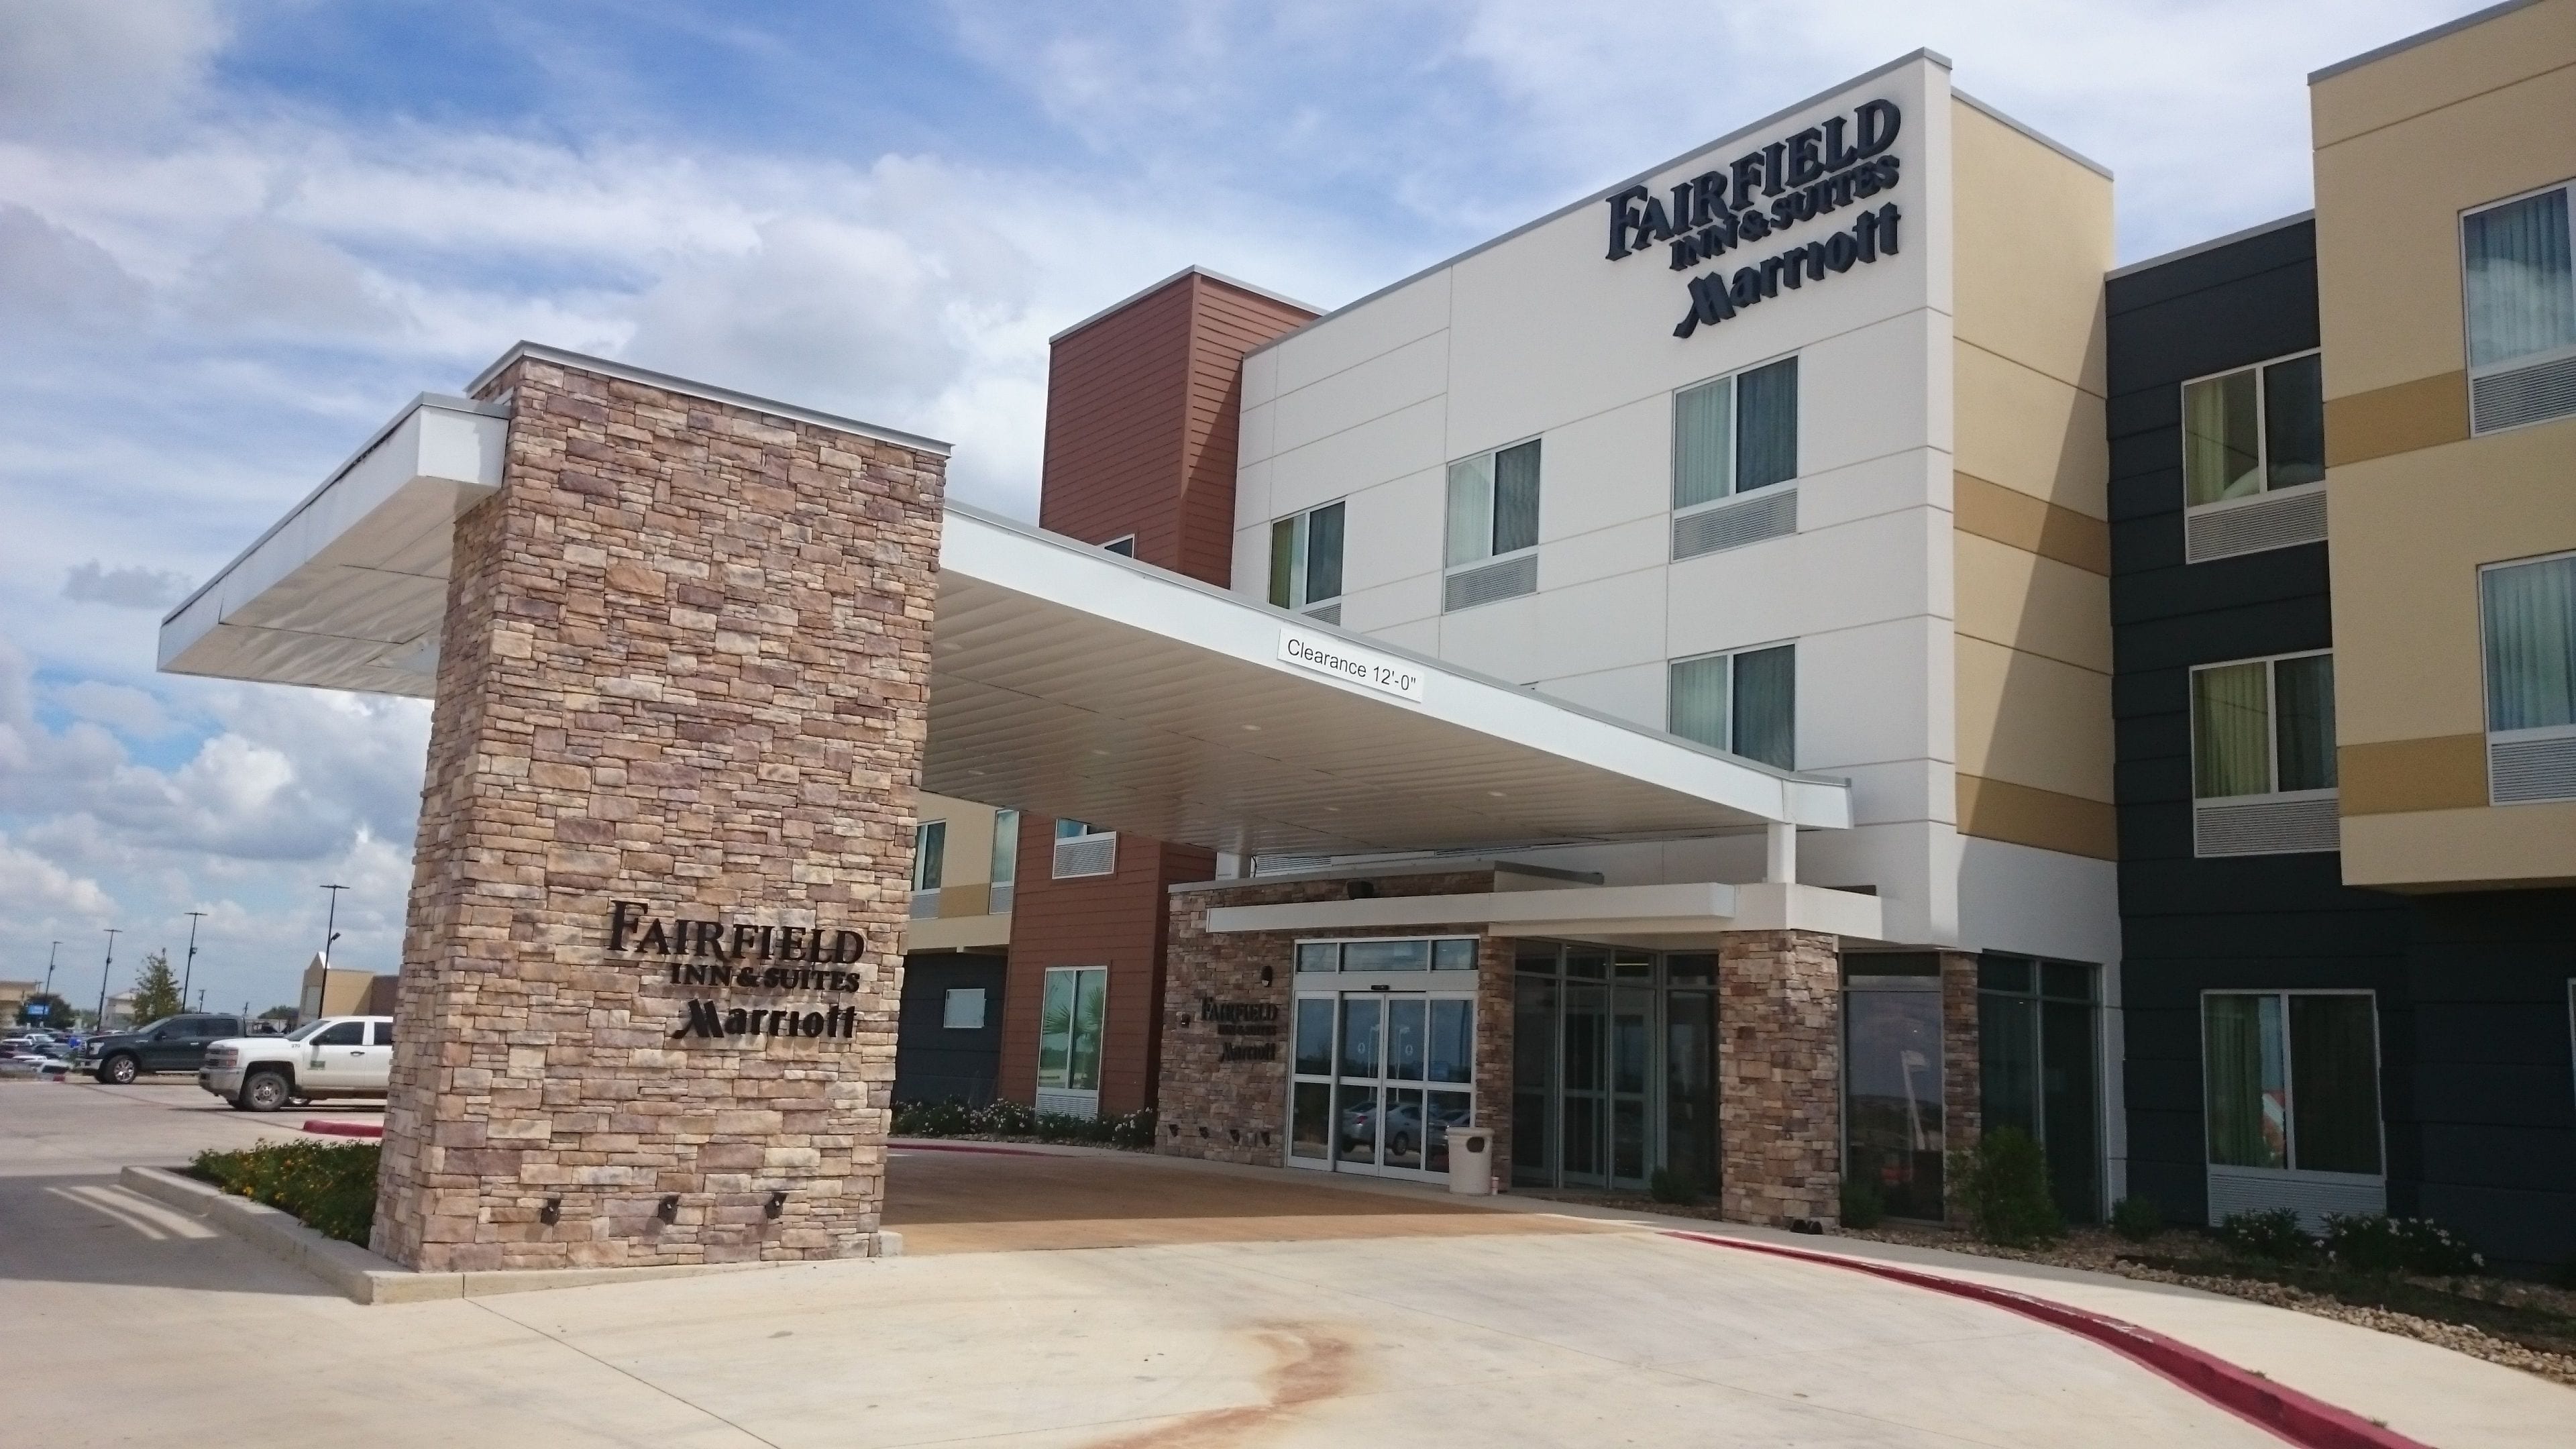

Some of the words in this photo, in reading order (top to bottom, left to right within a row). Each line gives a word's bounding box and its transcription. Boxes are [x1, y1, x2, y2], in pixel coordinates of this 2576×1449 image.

[1605, 98, 1901, 261] FAIRFIELD
[1669, 213, 1738, 271] INN
[1738, 210, 1772, 241] &
[1770, 155, 1900, 230] SUITES
[1672, 201, 1901, 339] Marriott
[1287, 639, 1366, 678] Clearance
[1373, 666, 1416, 691] 12'-0"
[606, 900, 864, 963] FAIRFIELD
[671, 963, 733, 986] INN
[737, 967, 759, 988] &
[764, 967, 860, 993] SUITES
[672, 998, 856, 1039] Marriott
